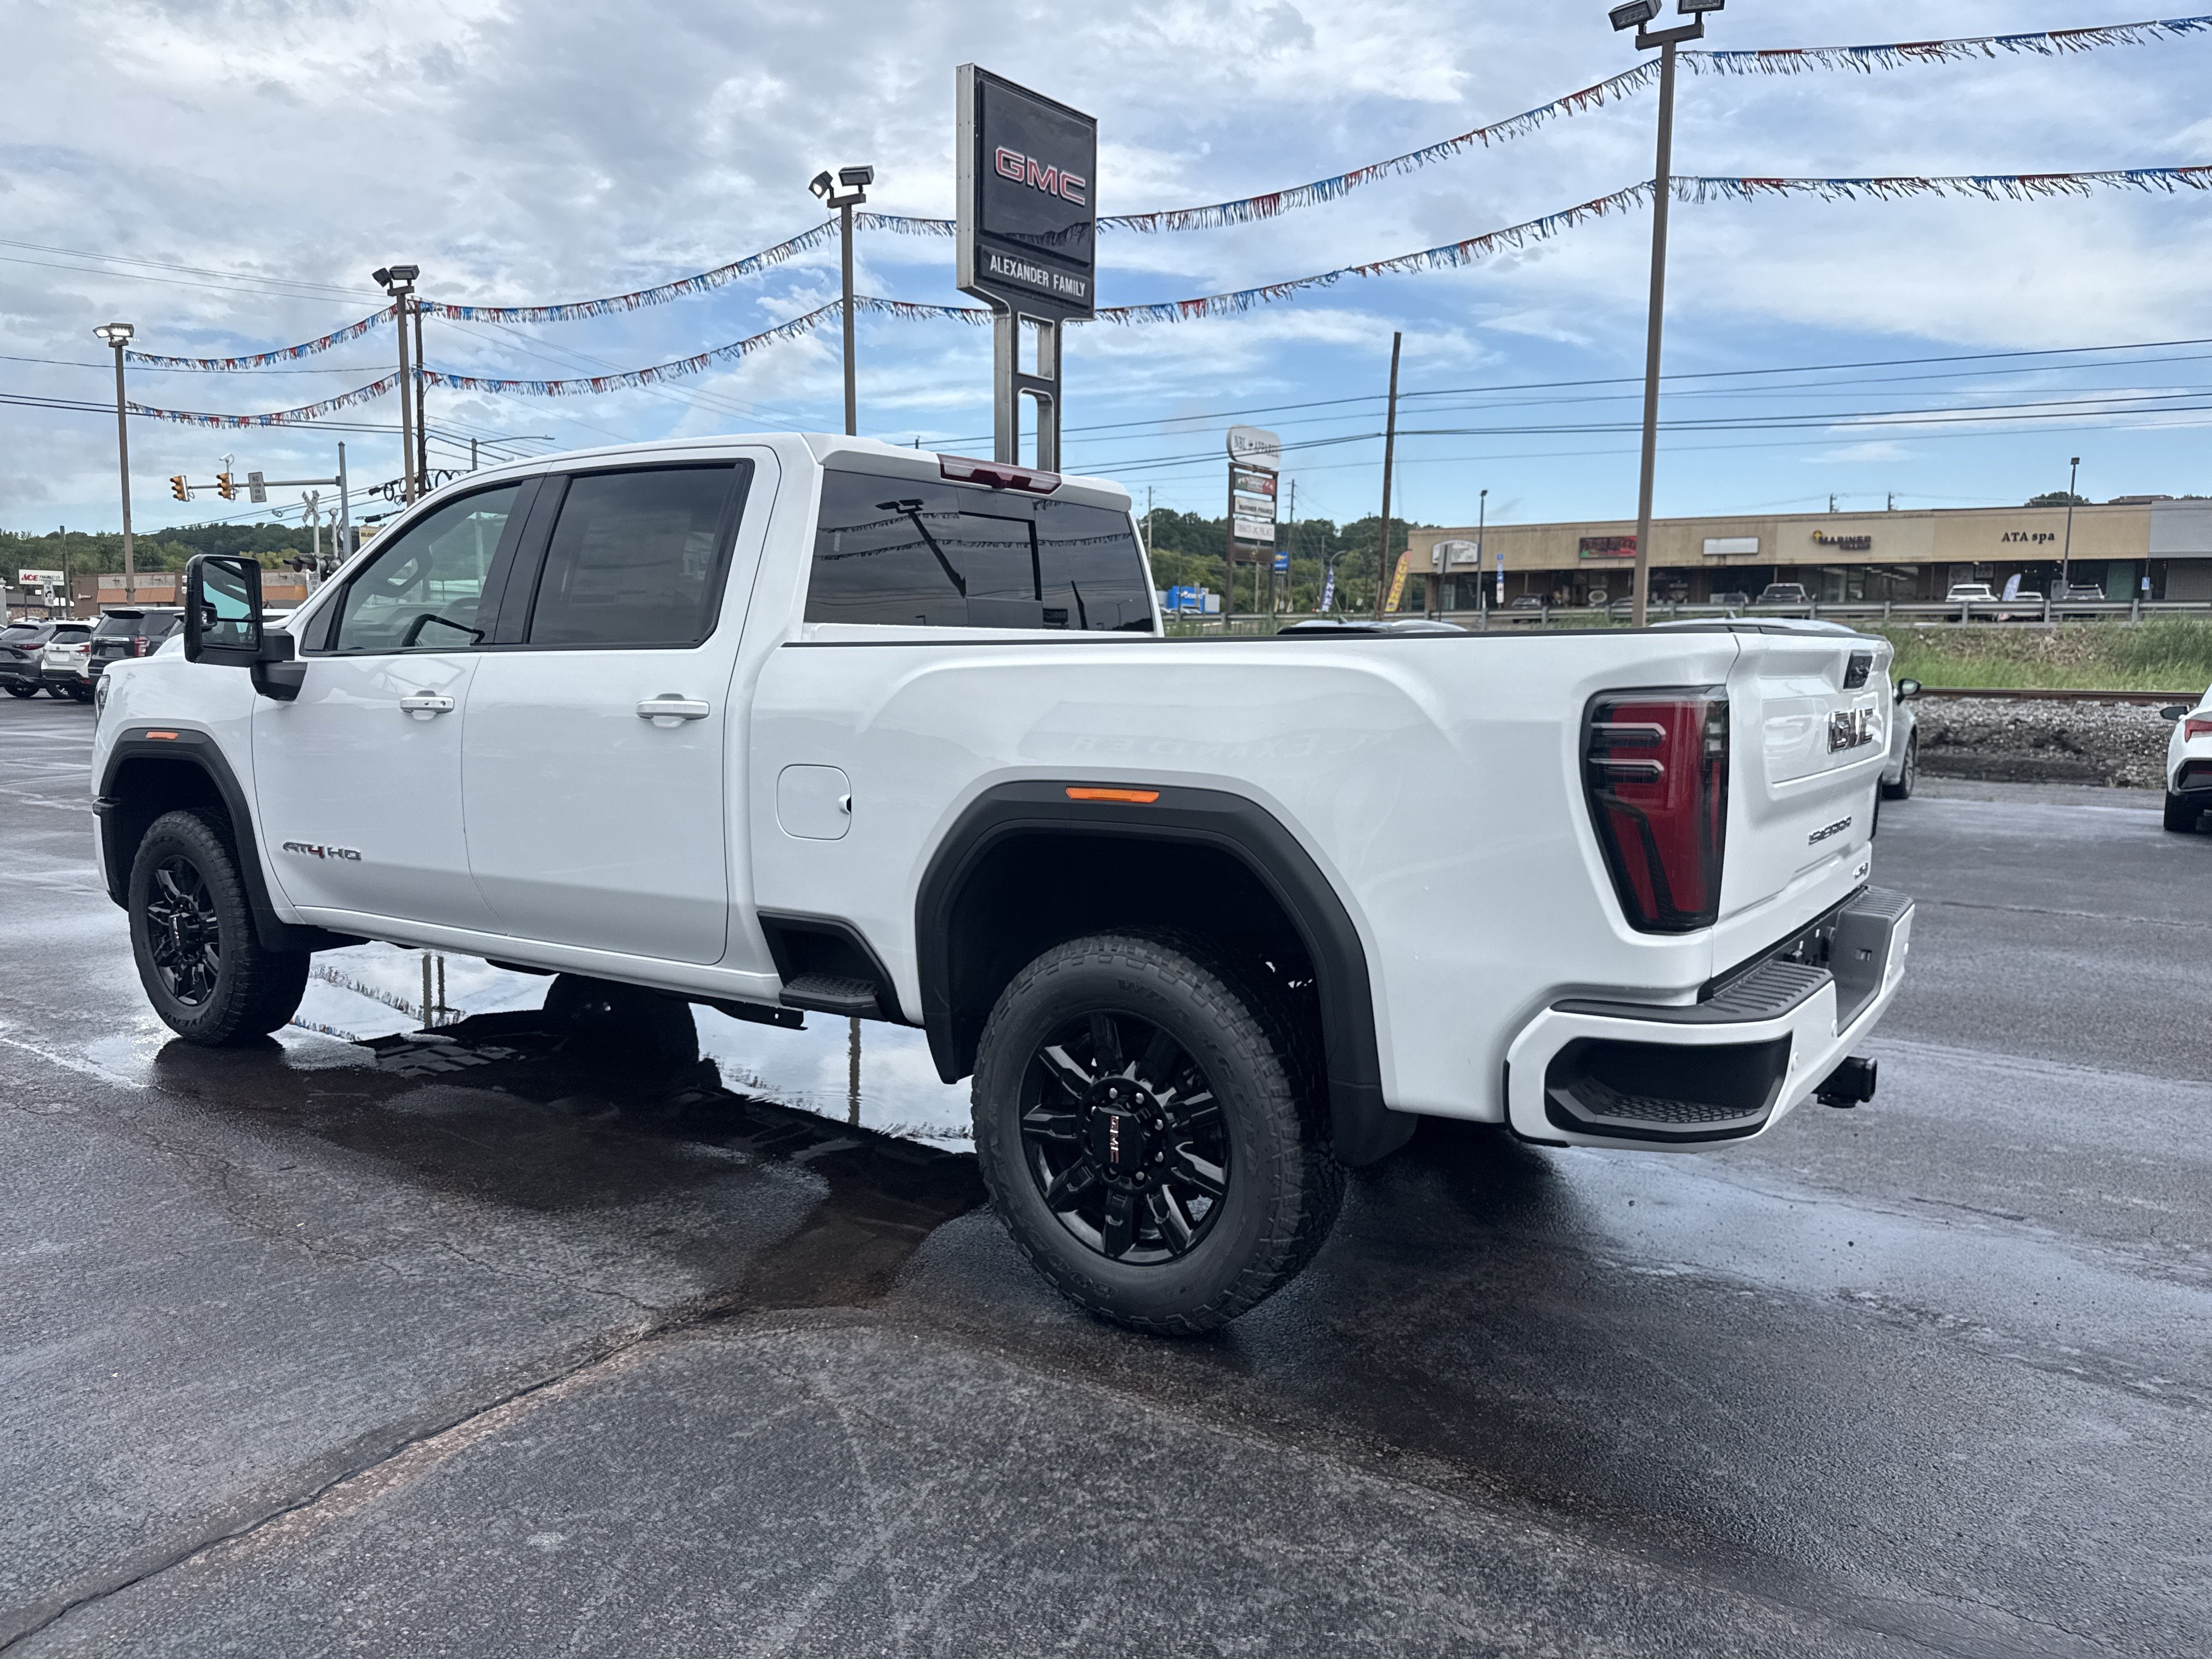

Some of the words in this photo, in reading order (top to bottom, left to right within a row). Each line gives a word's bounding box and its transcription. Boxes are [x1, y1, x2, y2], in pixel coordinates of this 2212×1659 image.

[995, 145, 1086, 205] GMC
[990, 255, 1049, 287] ALEXANDER
[1053, 274, 1086, 298] FAMILY
[1818, 536, 1871, 545] MARINER
[2001, 531, 2028, 542] ATA
[2032, 533, 2055, 544] spa
[1390, 556, 1408, 599] LUNCH
[328, 846, 362, 860] HD
